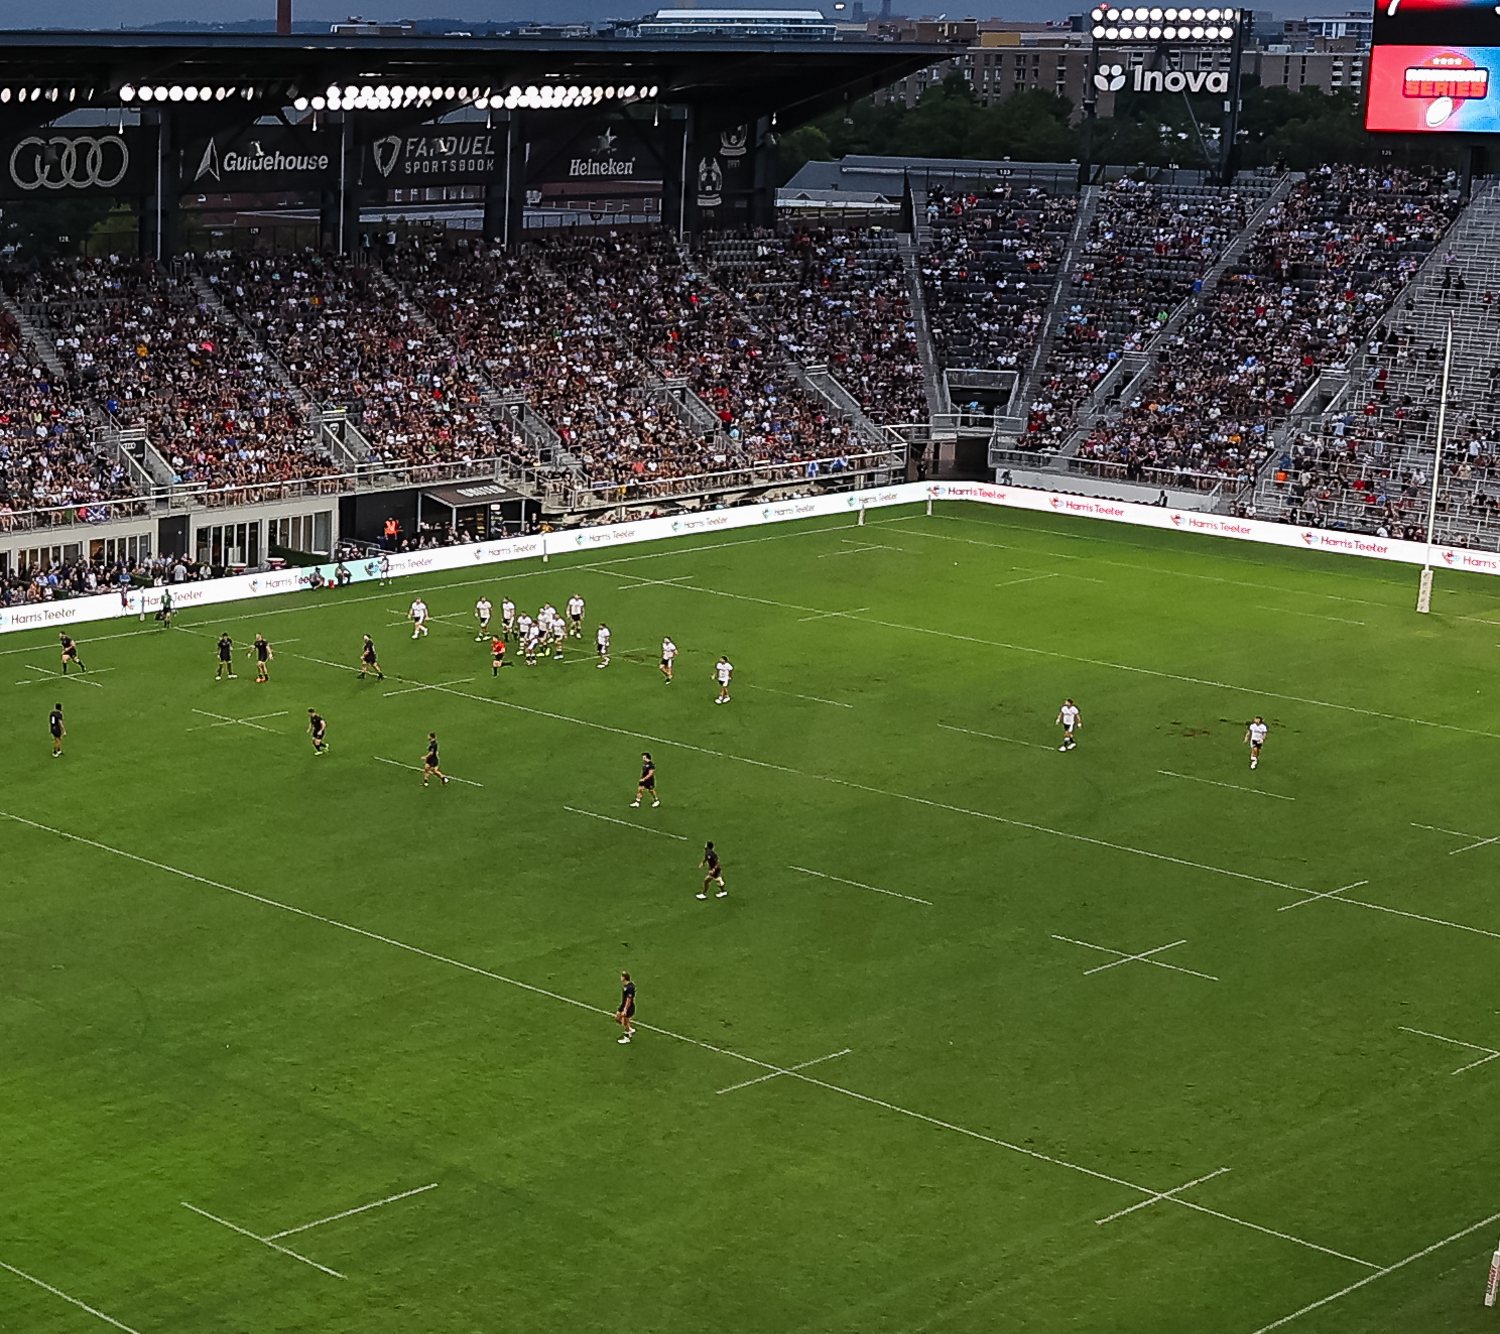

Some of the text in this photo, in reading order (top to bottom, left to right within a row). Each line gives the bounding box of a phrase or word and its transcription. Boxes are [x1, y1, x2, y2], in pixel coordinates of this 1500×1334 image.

[1133, 65, 1228, 93] Inova
[1406, 81, 1486, 97] SERIES
[405, 159, 494, 174] SPORTSBOOK
[569, 158, 633, 176] Heineken
[978, 488, 1005, 499] Teeter
[1066, 501, 1124, 516] Harris Teeter
[1190, 519, 1251, 534] Harris Teeter
[1321, 537, 1387, 553] Harris Teeter
[1464, 557, 1496, 568] Harris
[12, 609, 75, 624] Harris Teeter
